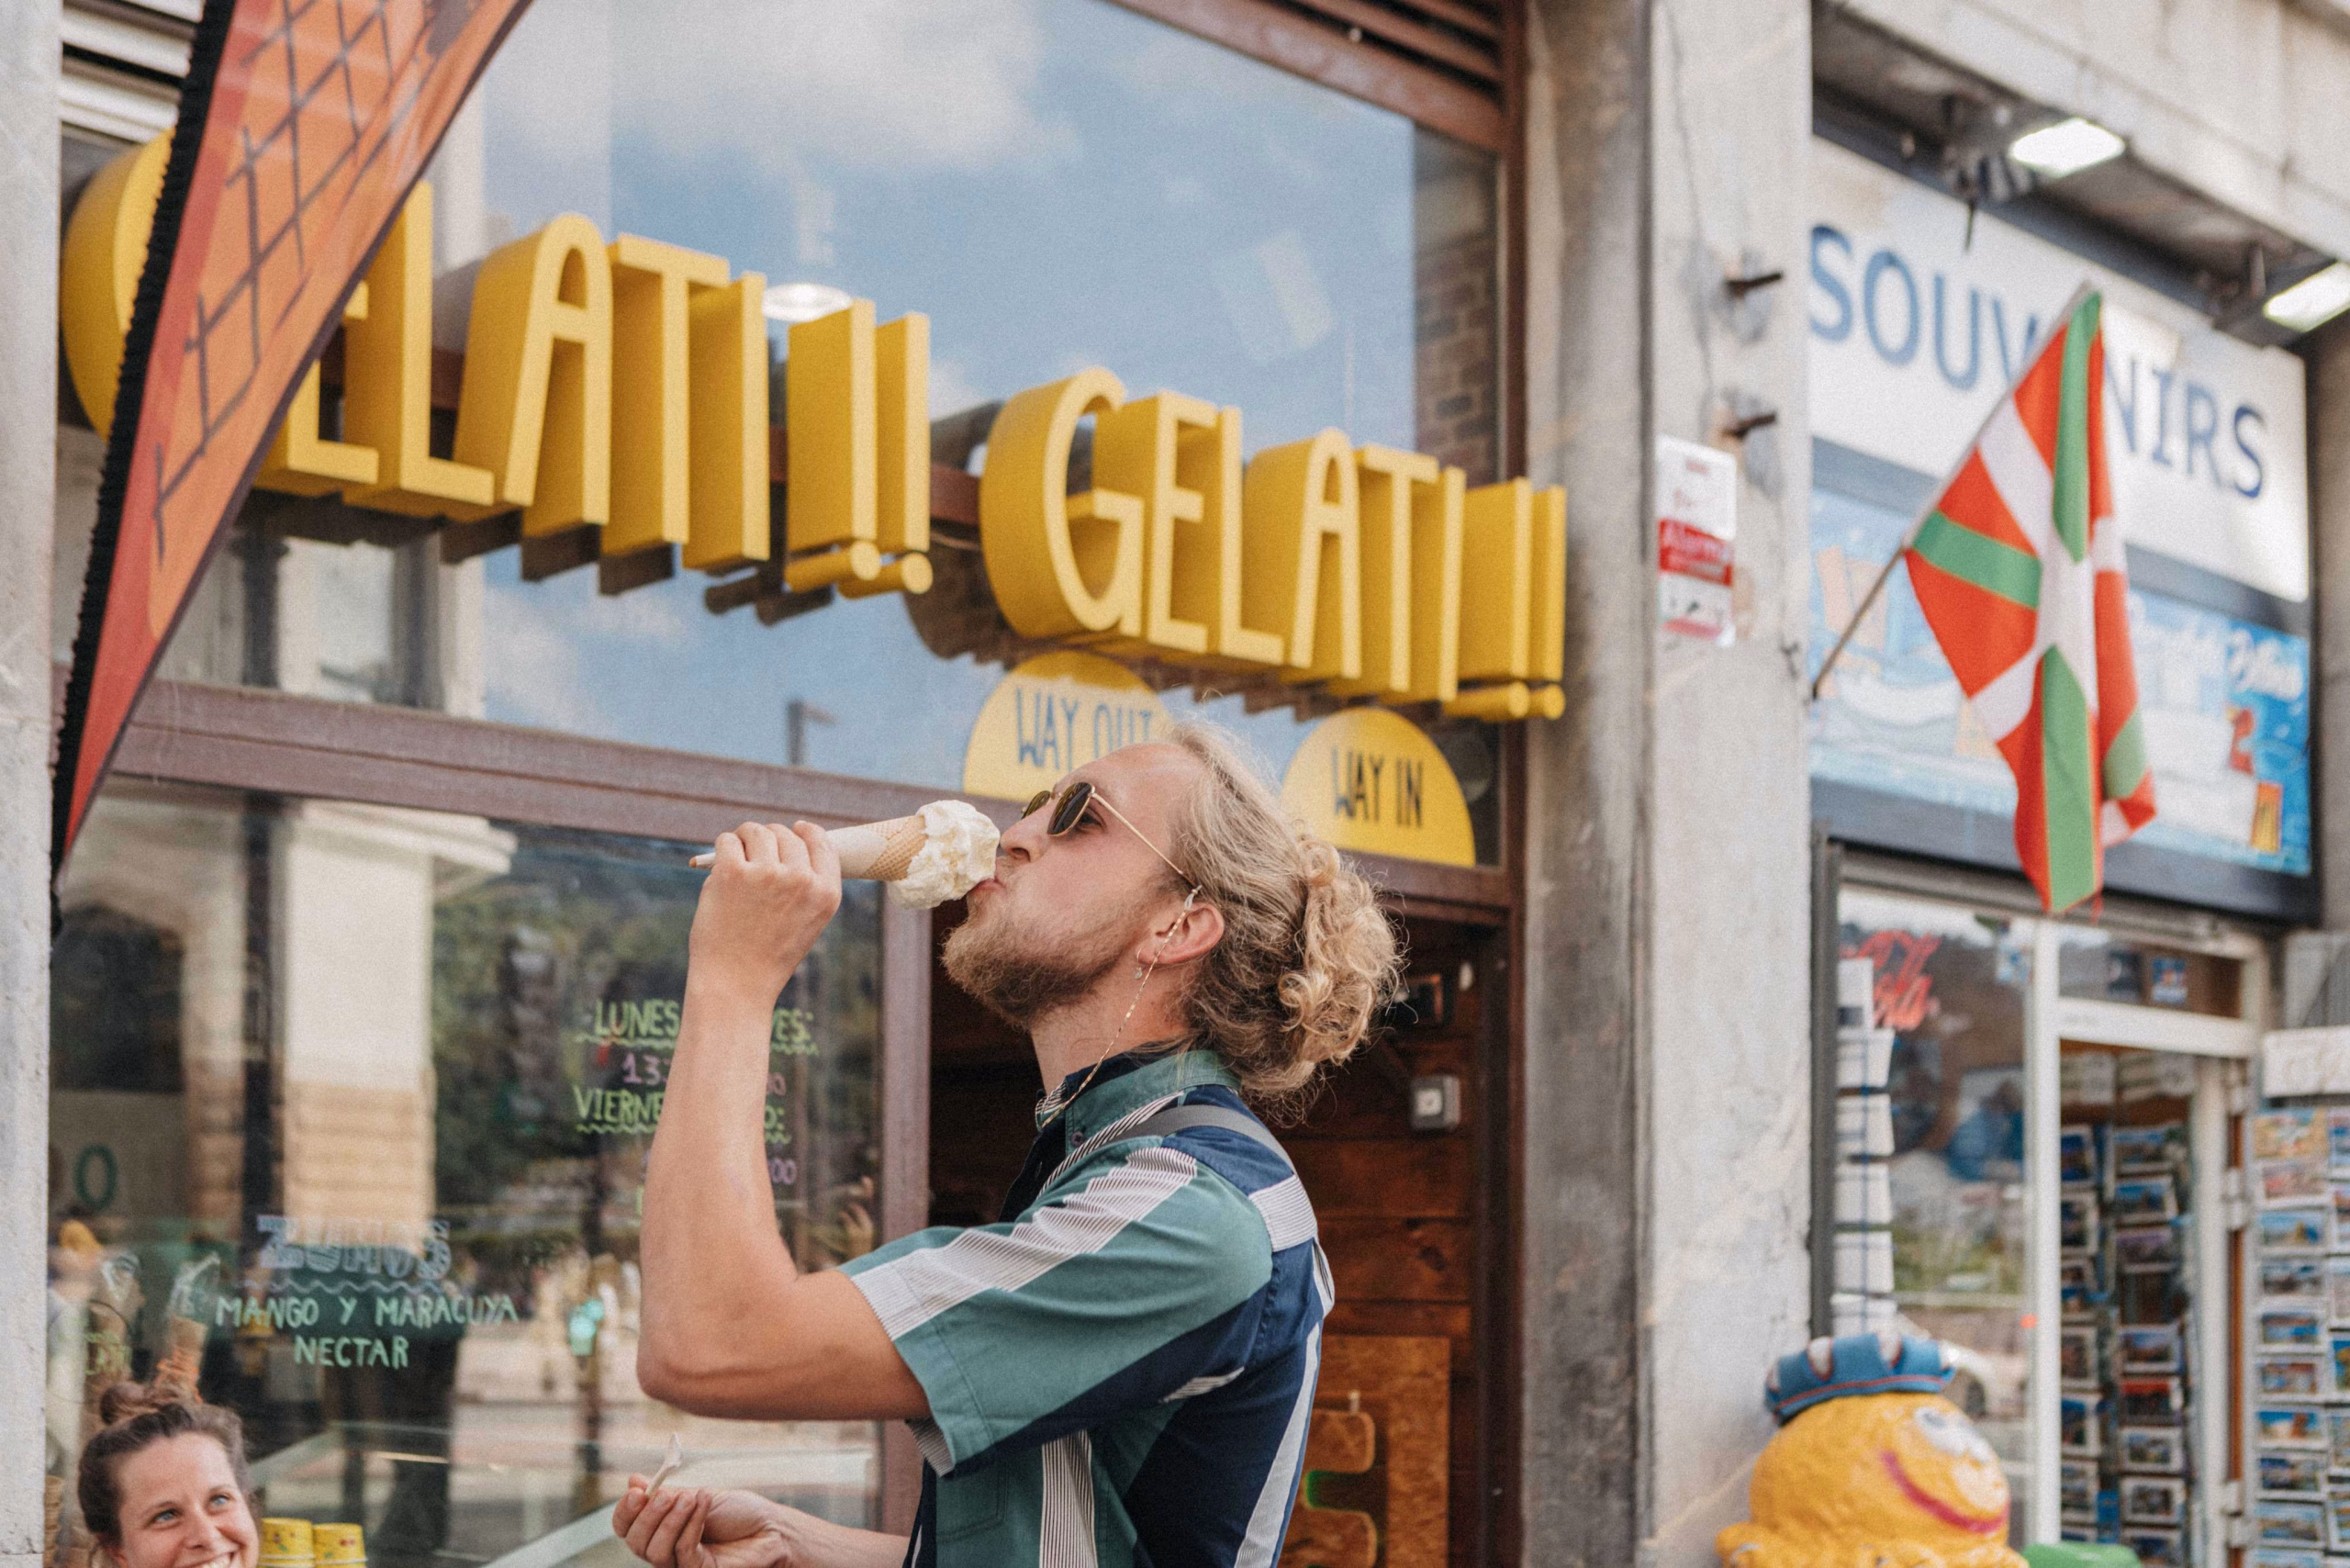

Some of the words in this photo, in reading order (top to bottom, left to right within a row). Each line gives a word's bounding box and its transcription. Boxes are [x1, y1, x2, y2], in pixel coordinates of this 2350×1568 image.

[1809, 224, 2265, 498] SOUVNIRS
[984, 367, 1566, 721] GELATI!!
[1015, 687, 1080, 772] WAY
[1331, 745, 1385, 823] WAY
[1395, 757, 1423, 828] IN
[595, 998, 680, 1039] LUNES
[573, 1085, 666, 1124] VIERNE
[215, 1295, 320, 1329] MANGO
[338, 1295, 358, 1326] Y
[294, 1334, 410, 1370] NECTAR
